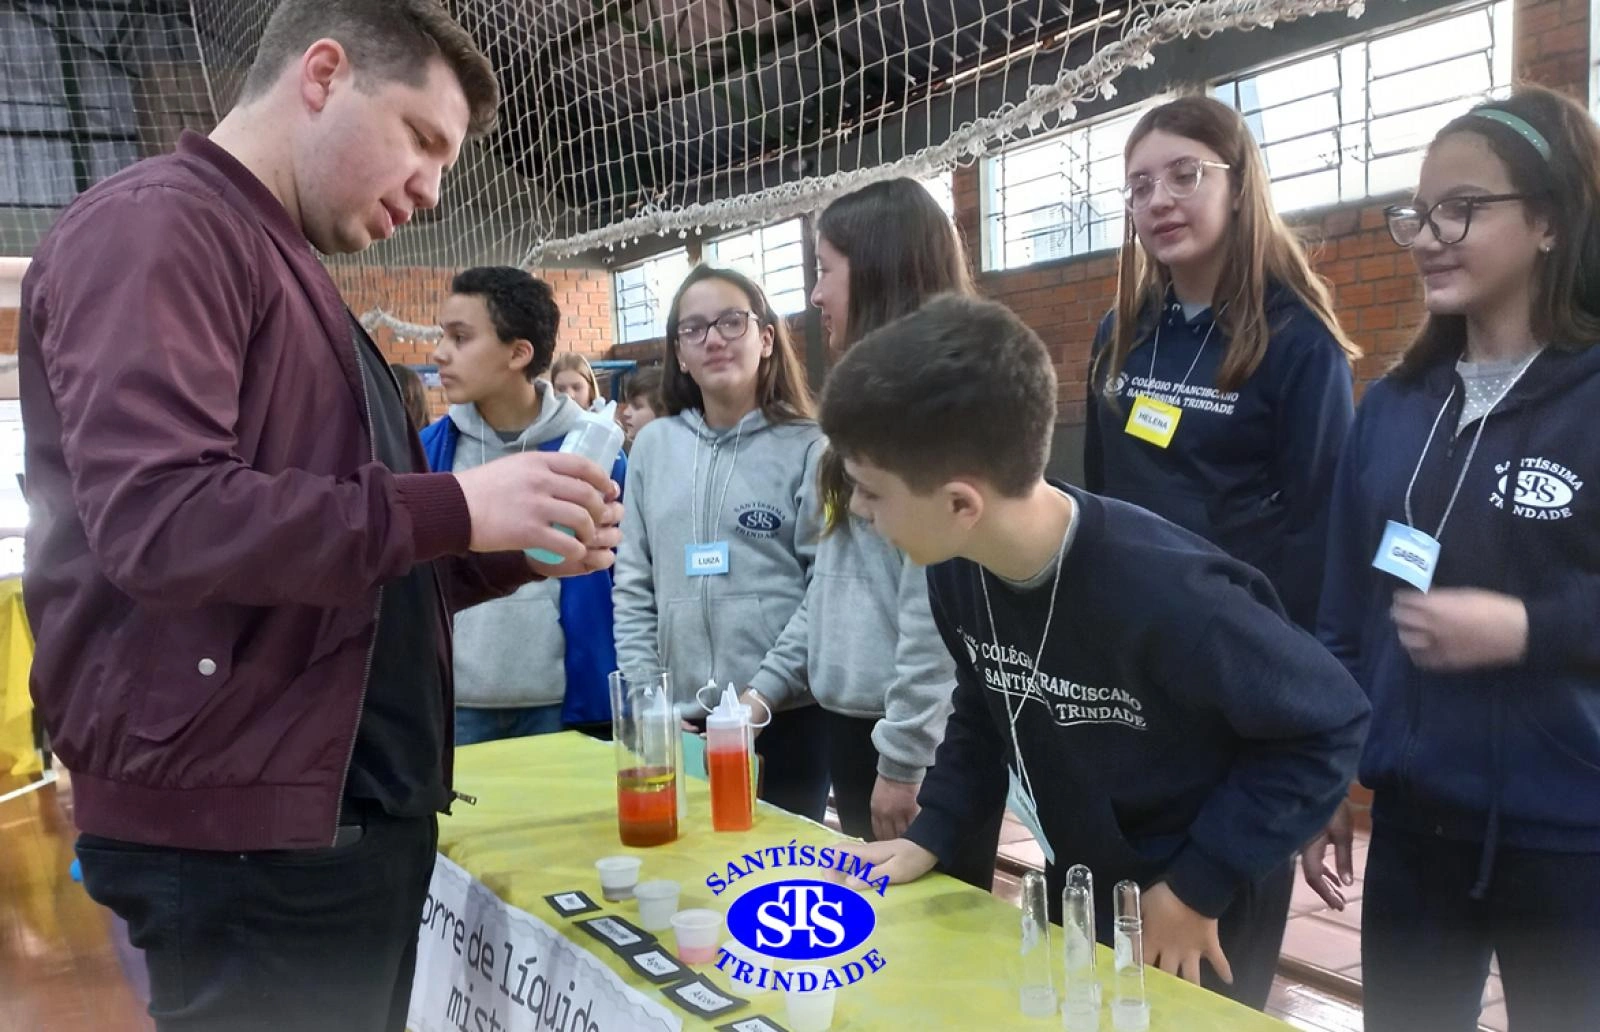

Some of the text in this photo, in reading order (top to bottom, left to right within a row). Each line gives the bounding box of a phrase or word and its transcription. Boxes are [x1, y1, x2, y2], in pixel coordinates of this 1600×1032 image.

[1131, 376, 1172, 391] COLÉGIO
[1183, 397, 1235, 415] TRINDADE
[1138, 412, 1168, 430] HELENA
[1055, 703, 1147, 727] TRINDADE
[421, 893, 465, 956] orre
[467, 924, 495, 982] de
